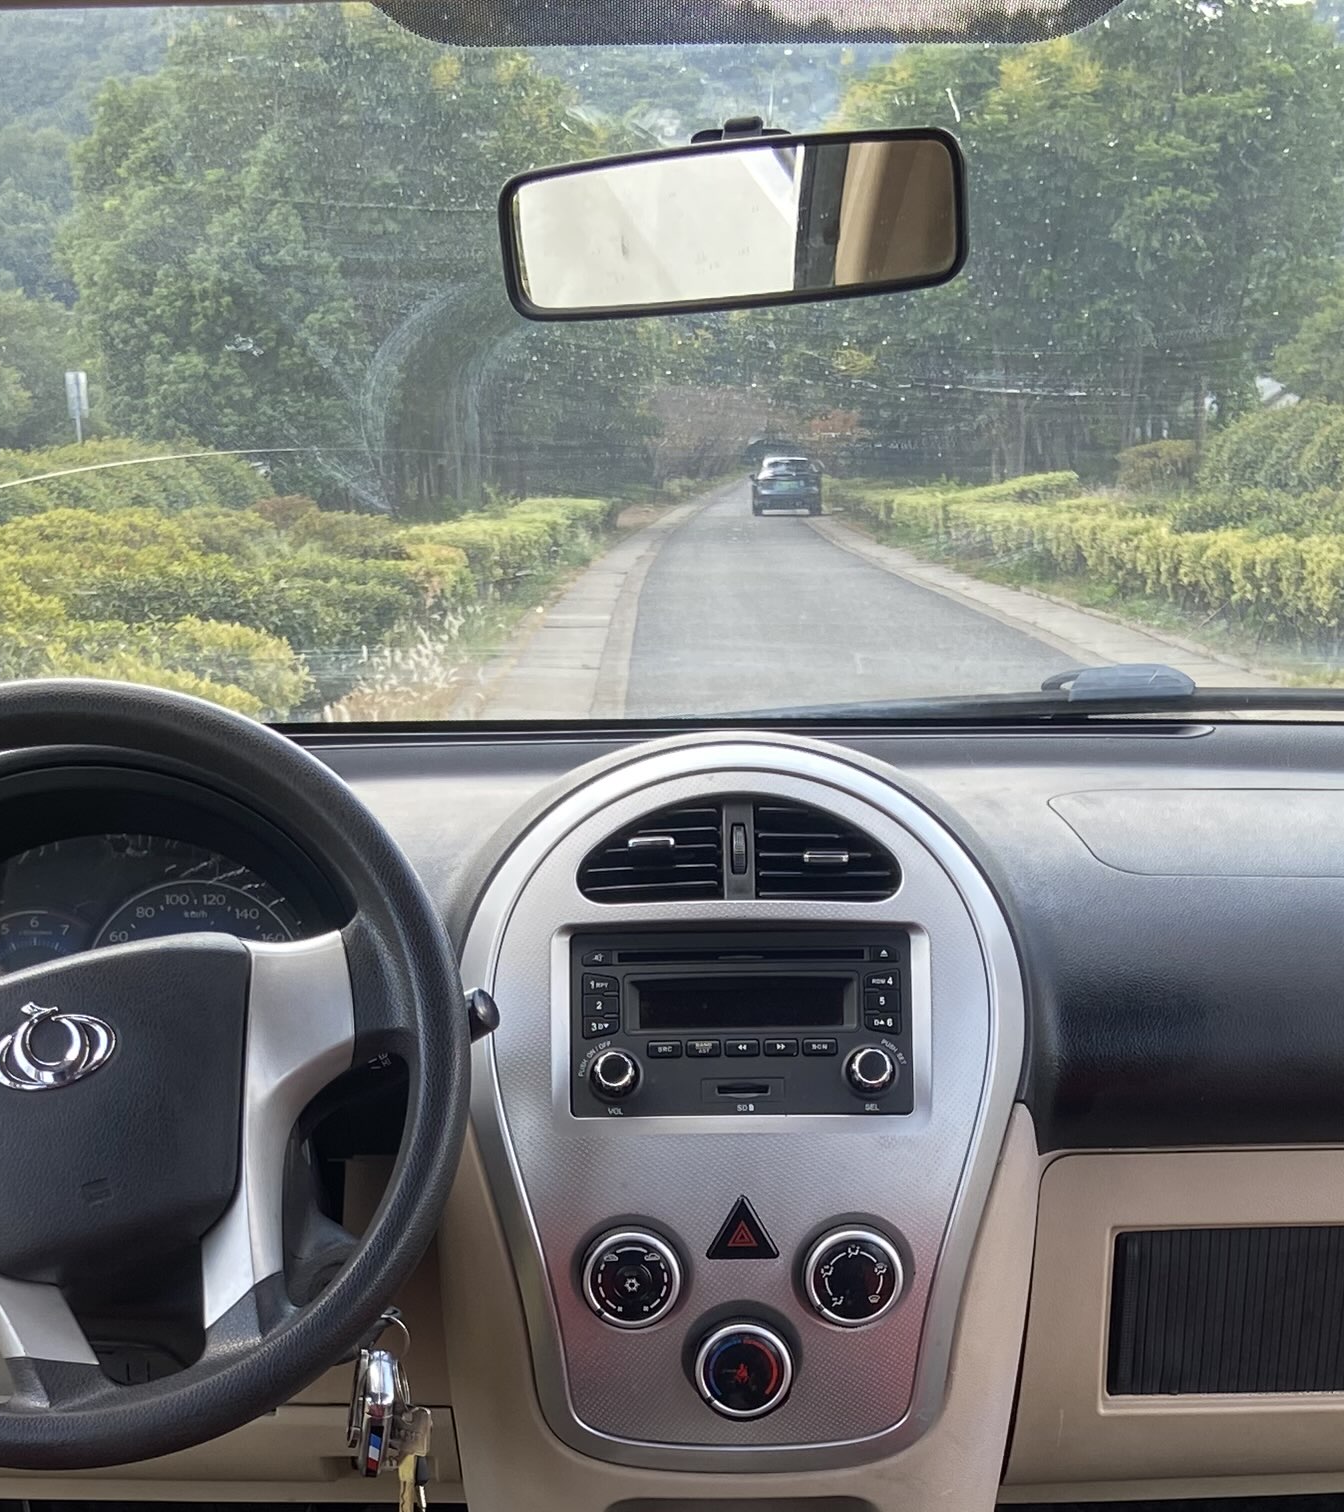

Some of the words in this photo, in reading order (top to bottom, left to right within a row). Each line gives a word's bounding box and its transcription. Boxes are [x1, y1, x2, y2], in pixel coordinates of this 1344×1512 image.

[164, 894, 190, 906] 100
[202, 894, 227, 906] 120
[135, 906, 156, 918] 80
[234, 908, 260, 920] 140
[30, 916, 40, 928] 6
[0, 923, 10, 935] 5
[58, 924, 70, 936] 7
[109, 930, 129, 943] 60
[261, 932, 286, 942] 160
[589, 980, 595, 989] 1
[887, 976, 893, 985] 4
[596, 1001, 603, 1010] 2
[879, 996, 885, 1006] 5
[591, 1022, 597, 1032] 3
[886, 1018, 893, 1027] 6
[657, 1045, 673, 1053] SRC
[881, 1038, 898, 1053] PUSH
[578, 1058, 587, 1077] PUSH
[607, 1107, 624, 1116] VOL
[737, 1104, 748, 1112] SD
[864, 1103, 880, 1111] SEL
